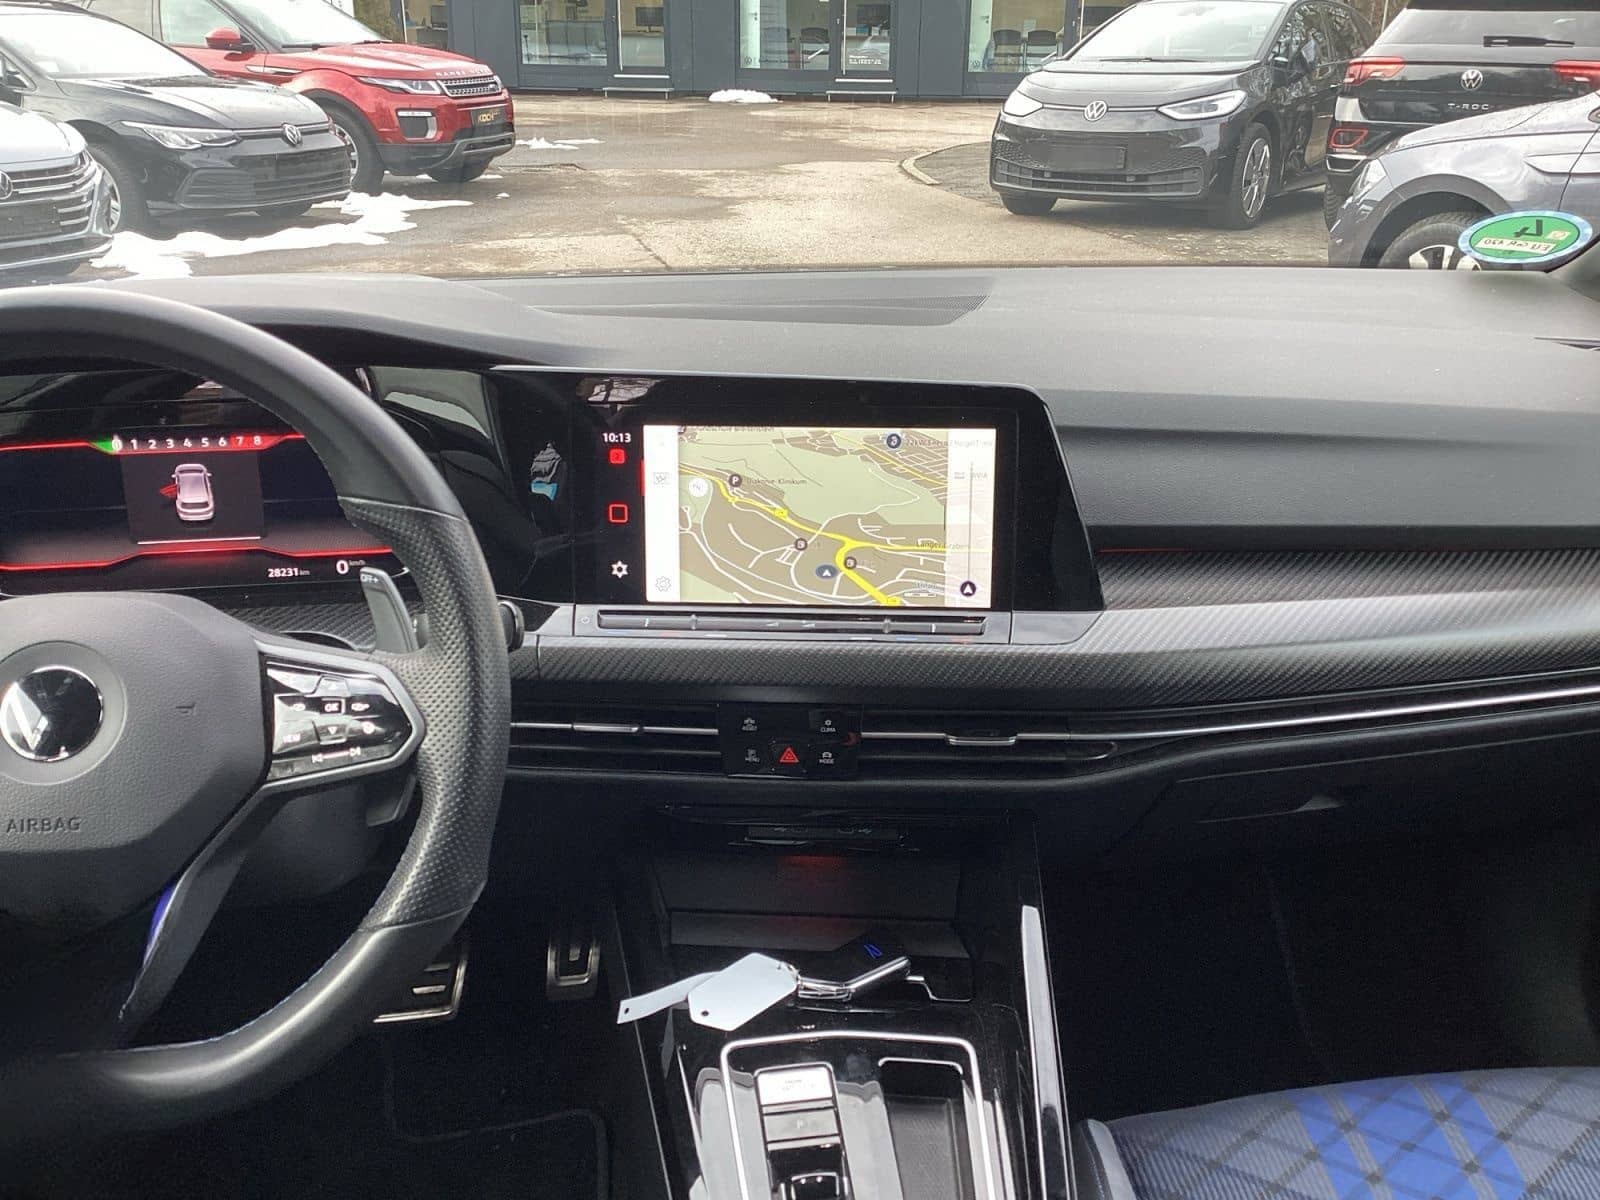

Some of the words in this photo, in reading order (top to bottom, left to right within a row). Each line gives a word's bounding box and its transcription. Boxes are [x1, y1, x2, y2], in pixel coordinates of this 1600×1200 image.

[131, 438, 138, 450] 1
[150, 439, 157, 449] 2
[166, 438, 174, 449] 3
[183, 438, 192, 448] 4
[201, 437, 209, 448] 5
[218, 437, 227, 447] 6
[236, 436, 243, 446] 7
[253, 435, 262, 446] 8
[602, 432, 631, 443] 10:13
[268, 567, 299, 578] 28231
[336, 560, 349, 575] 0
[6, 816, 82, 834] AIRBAG
